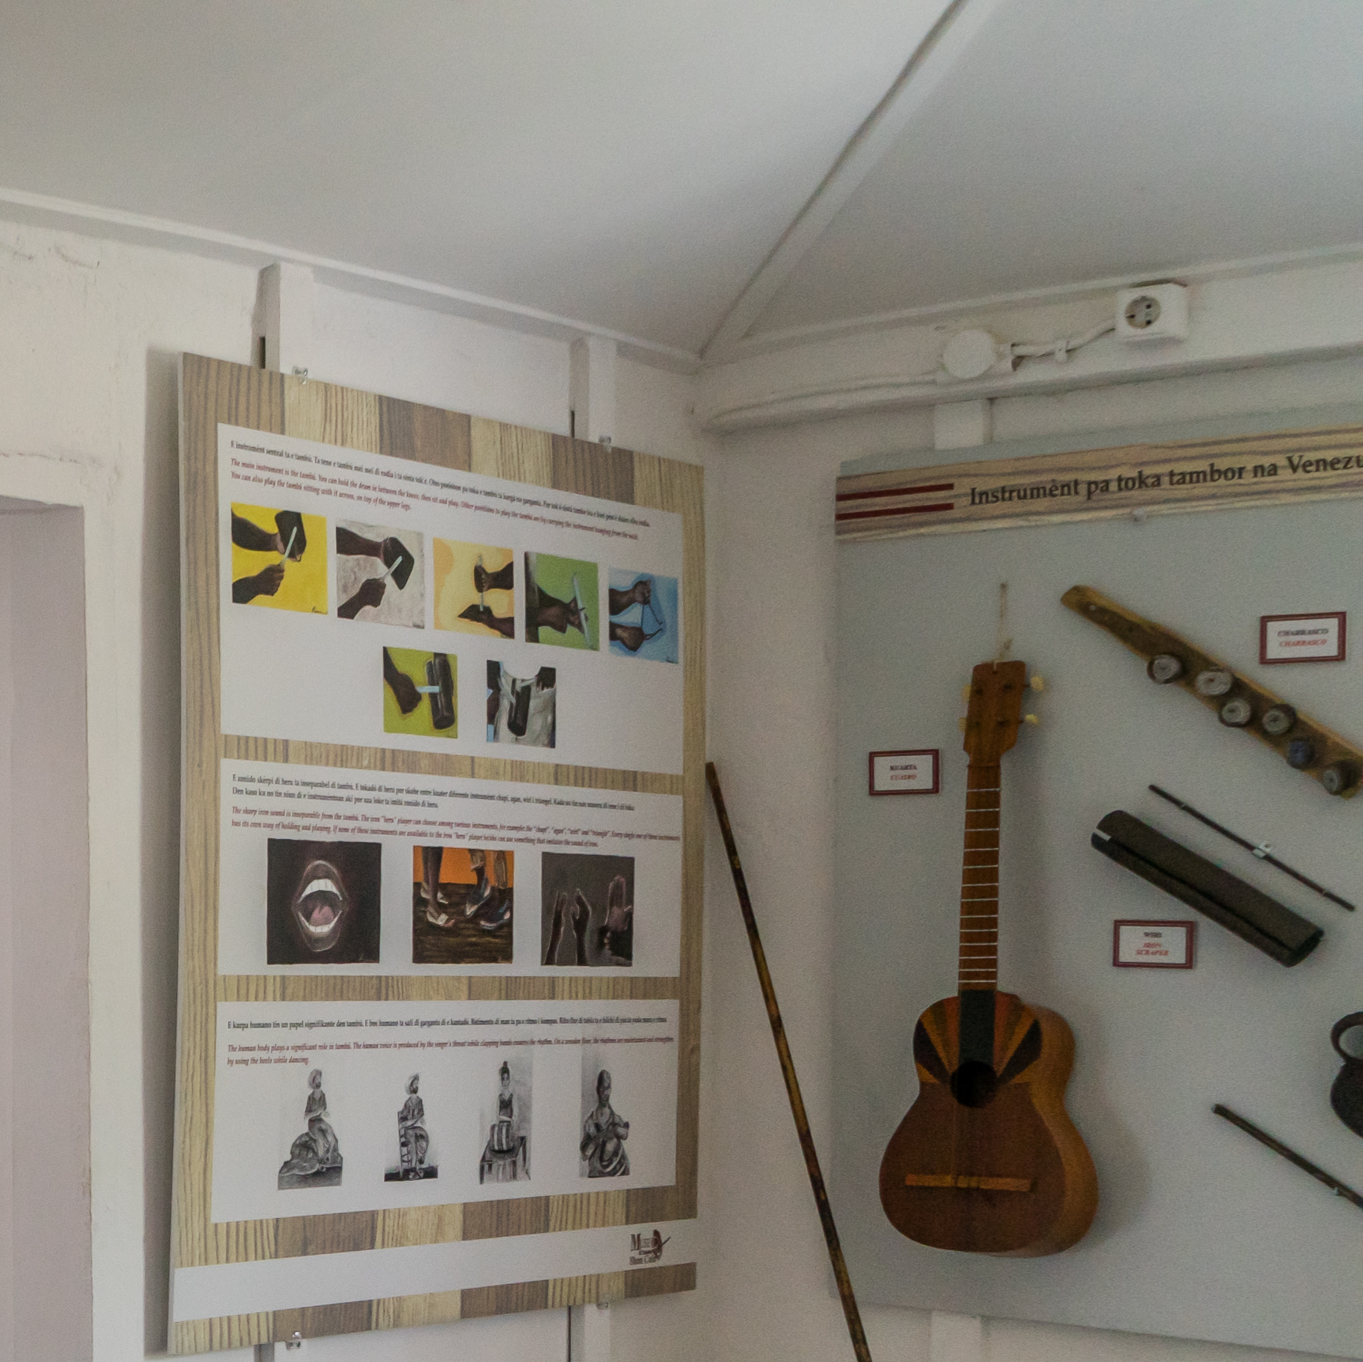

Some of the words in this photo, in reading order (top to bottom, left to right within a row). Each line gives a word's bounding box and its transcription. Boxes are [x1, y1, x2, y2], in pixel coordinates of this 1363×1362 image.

[230, 457, 239, 466] The
[255, 462, 283, 474] instrument
[284, 467, 289, 475] is
[290, 469, 298, 477] the
[318, 473, 326, 482] You
[337, 477, 348, 486] hold
[230, 470, 240, 479] You
[251, 474, 263, 483] also
[263, 476, 275, 487] play
[276, 478, 284, 487] the
[970, 478, 1079, 506] Instrumènt
[1087, 480, 1110, 499] pa
[1117, 470, 1162, 491] toka
[1168, 463, 1246, 486] tambor
[1252, 463, 1277, 478] na
[227, 1044, 237, 1052] The
[257, 1043, 269, 1053] body
[226, 1058, 233, 1067] by
[234, 1057, 248, 1067] using
[249, 1057, 258, 1065] the
